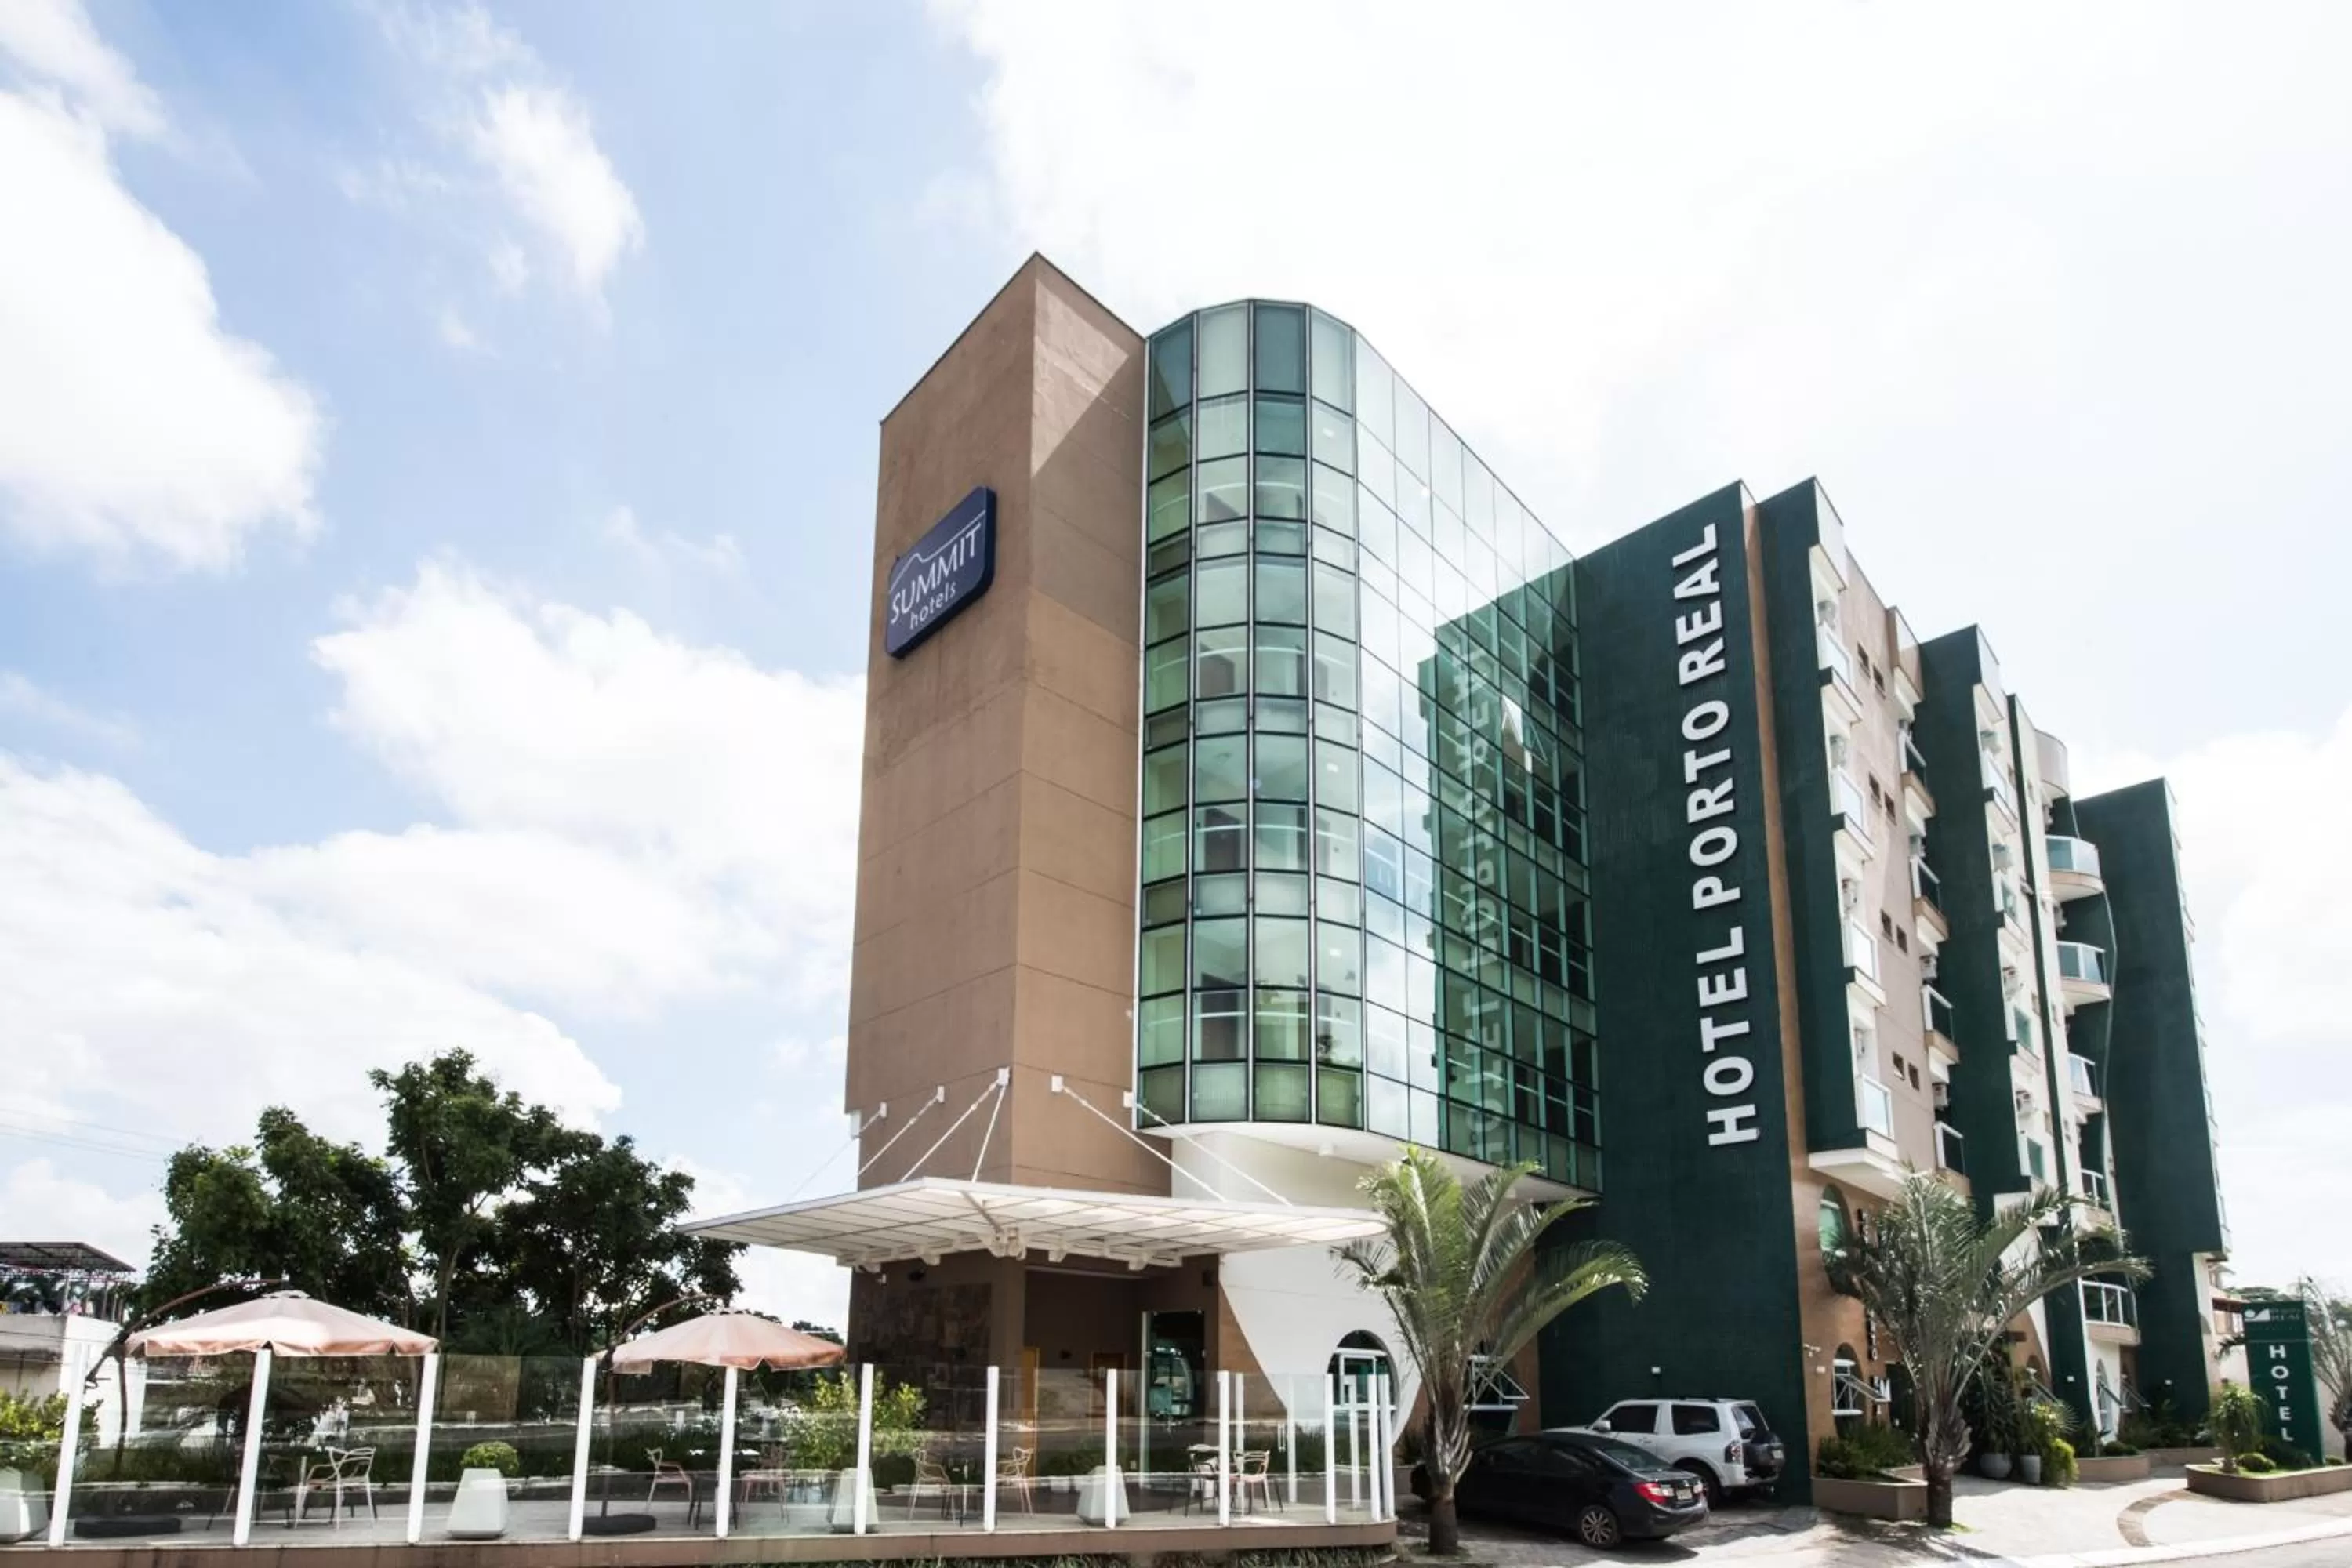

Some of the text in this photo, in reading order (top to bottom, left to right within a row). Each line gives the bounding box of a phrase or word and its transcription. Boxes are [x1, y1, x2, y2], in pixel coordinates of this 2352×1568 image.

[891, 523, 982, 624] SUMMIT
[910, 582, 956, 630] hotels
[1672, 523, 1759, 1145] HOTEL PORTO REAL
[2269, 1345, 2294, 1442] HOTEL
